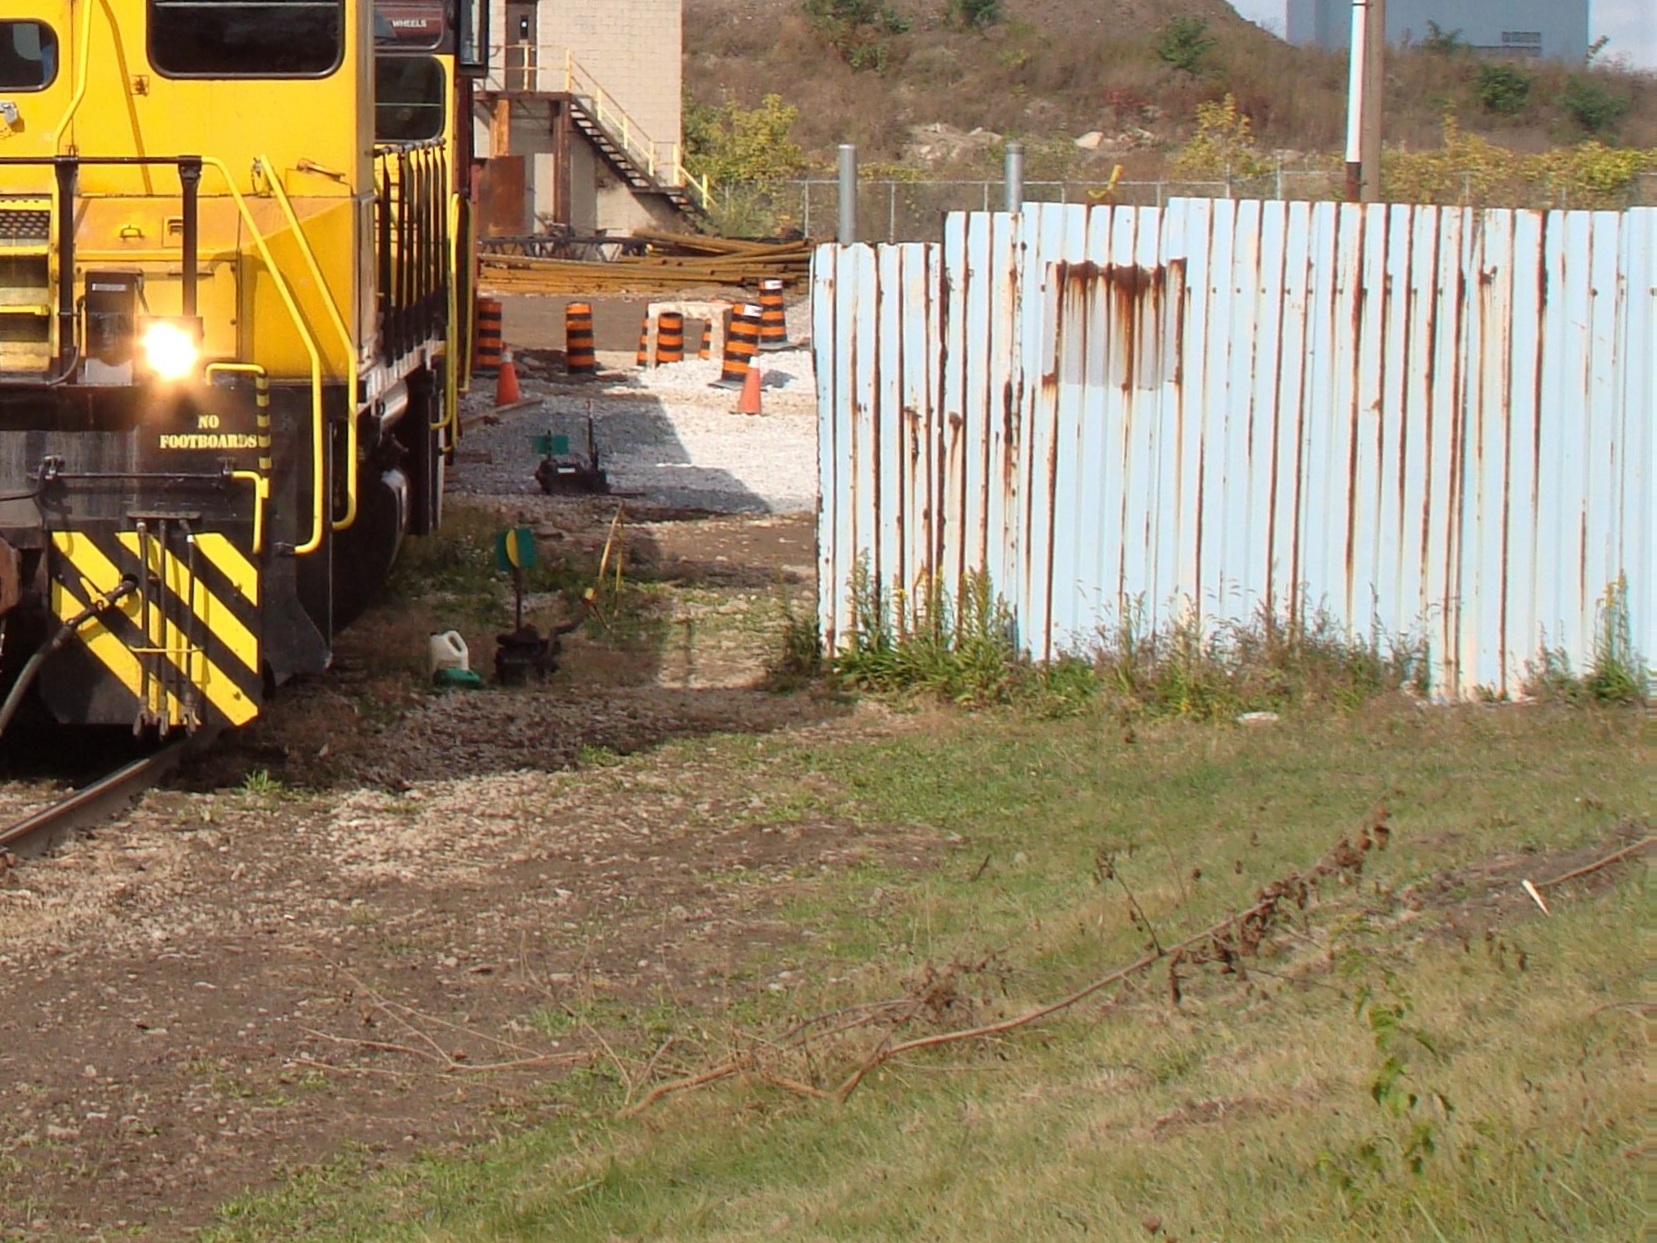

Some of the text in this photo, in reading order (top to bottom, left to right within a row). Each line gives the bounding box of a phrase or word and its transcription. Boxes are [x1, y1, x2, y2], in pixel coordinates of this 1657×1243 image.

[392, 19, 427, 28] WHEELS
[197, 414, 220, 428] NO
[159, 434, 257, 449] FOOTBOARDS
